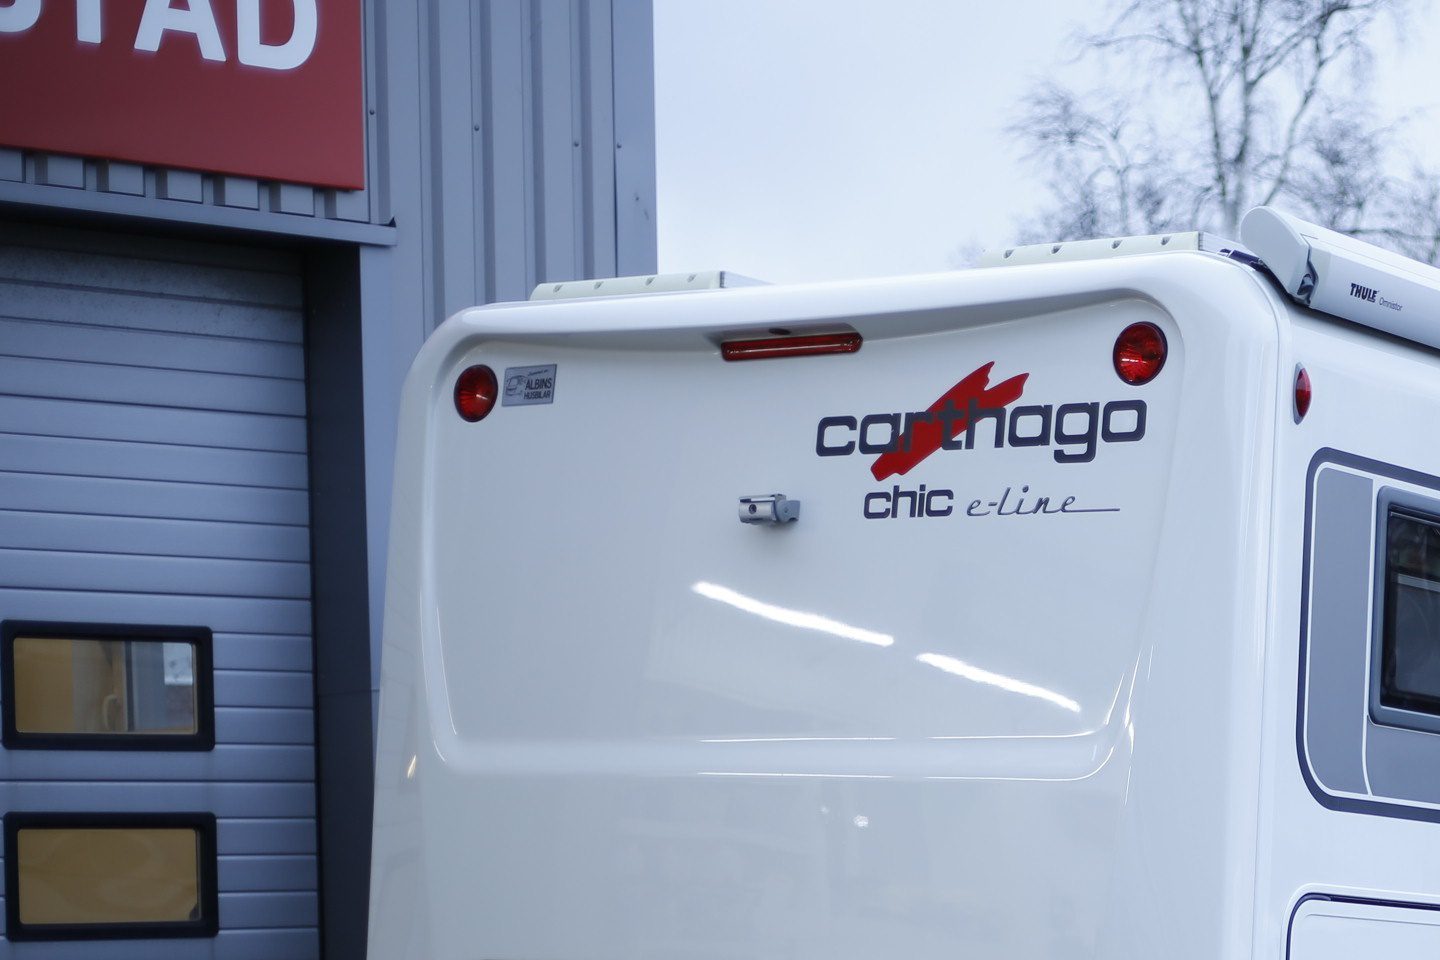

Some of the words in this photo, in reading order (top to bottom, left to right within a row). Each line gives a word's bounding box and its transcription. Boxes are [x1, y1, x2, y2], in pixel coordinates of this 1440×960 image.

[1350, 283, 1378, 303] THULE
[525, 377, 552, 391] ALBINS
[523, 390, 551, 400] HUSBILAR
[815, 399, 1147, 463] carthago
[863, 484, 954, 519] chic
[966, 484, 1121, 517] e-line
